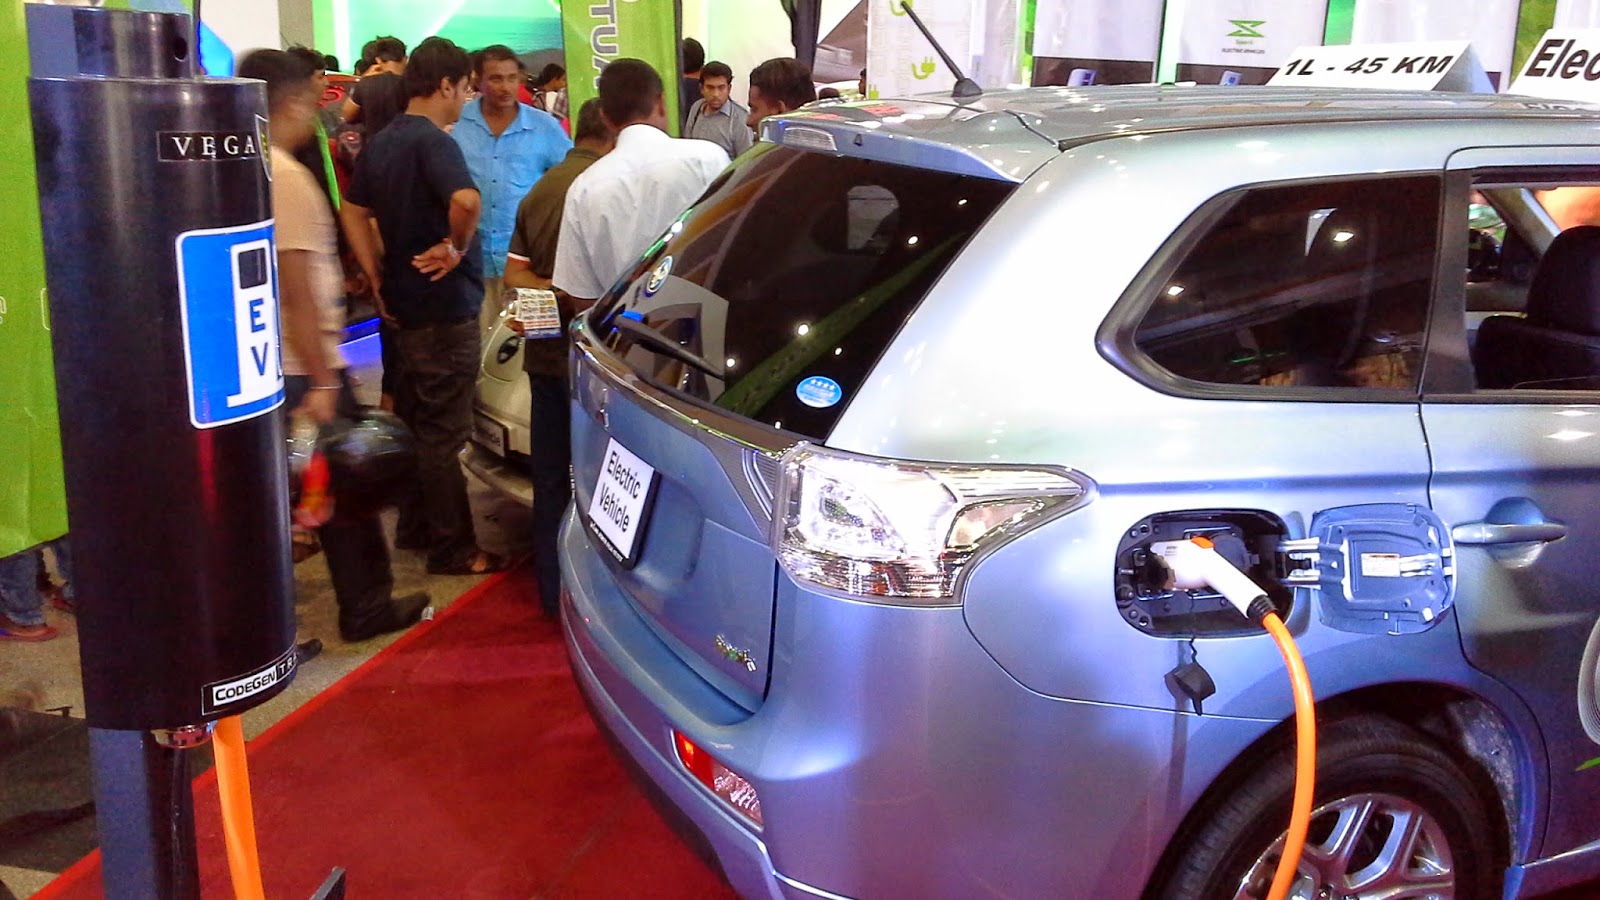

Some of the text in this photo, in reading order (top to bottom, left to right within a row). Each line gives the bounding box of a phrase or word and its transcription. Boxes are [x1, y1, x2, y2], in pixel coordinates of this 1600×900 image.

[1285, 59, 1315, 76] 1L
[1343, 57, 1389, 74] 45
[1391, 55, 1454, 74] KM
[1524, 38, 1600, 82] Elec
[171, 133, 257, 157] VEGA
[606, 450, 642, 499] Electric
[599, 481, 630, 533] Vehicle
